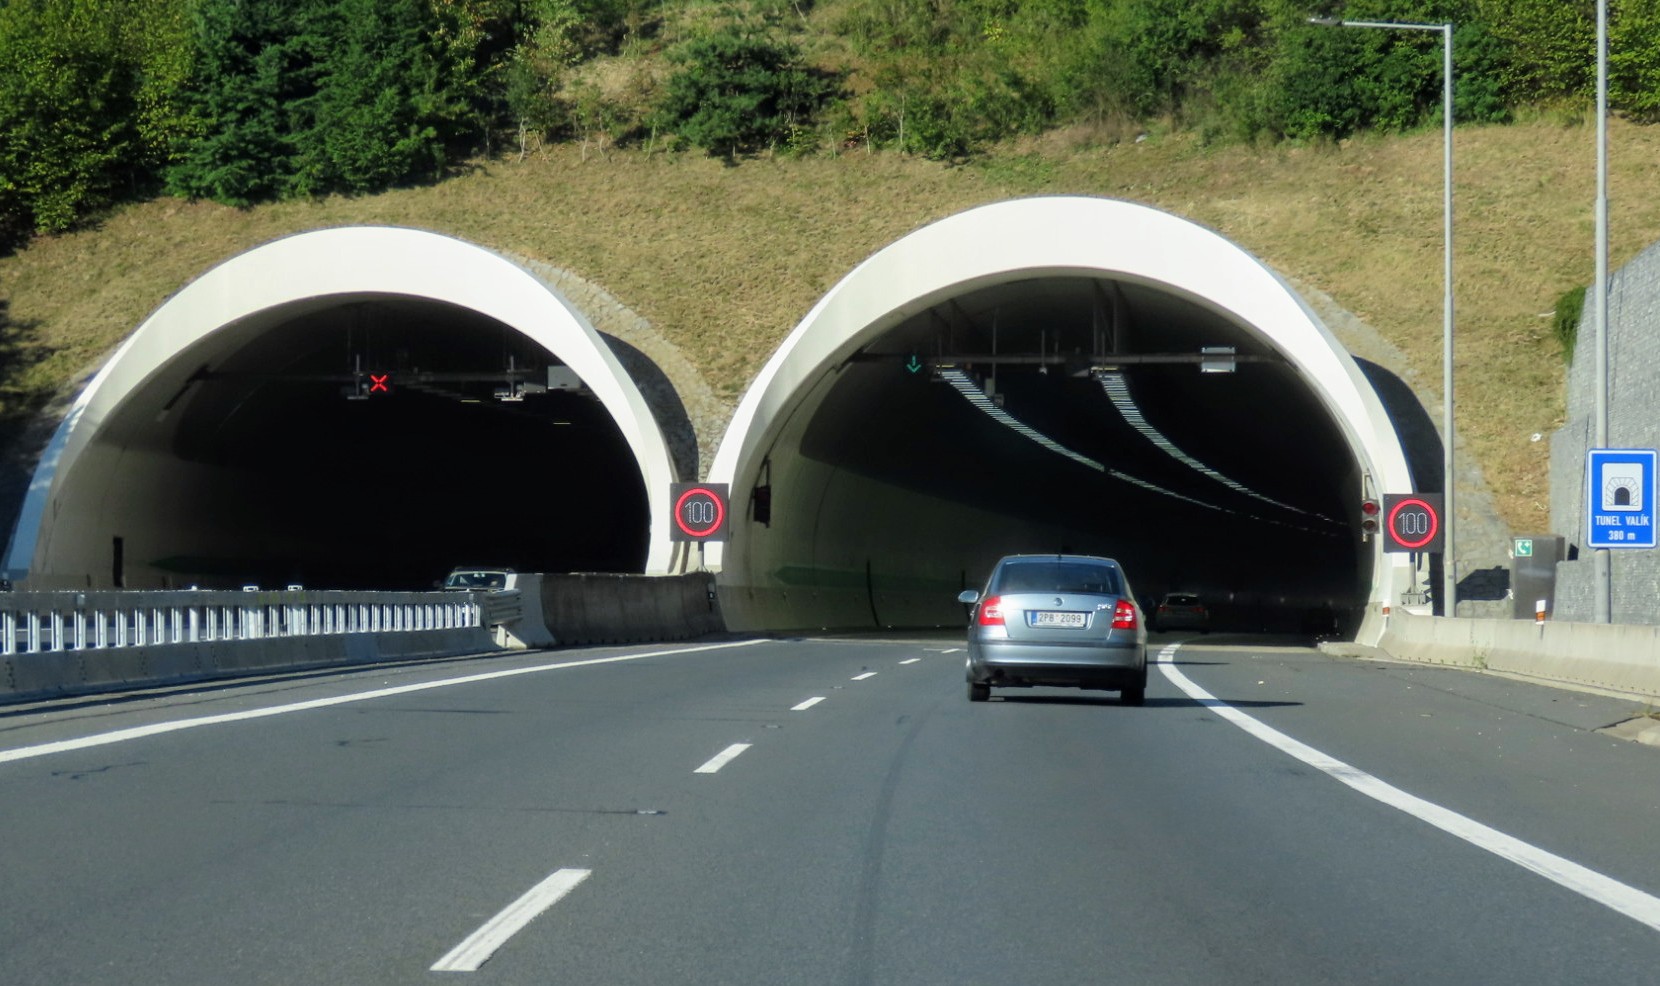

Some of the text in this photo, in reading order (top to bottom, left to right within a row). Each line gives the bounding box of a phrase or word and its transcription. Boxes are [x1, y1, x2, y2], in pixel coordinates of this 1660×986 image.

[684, 501, 714, 524] 100
[1398, 512, 1428, 535] 100
[1595, 513, 1650, 526] TUNEL VALÍK
[1608, 530, 1636, 540] 380 m
[1060, 614, 1082, 623] 2099
